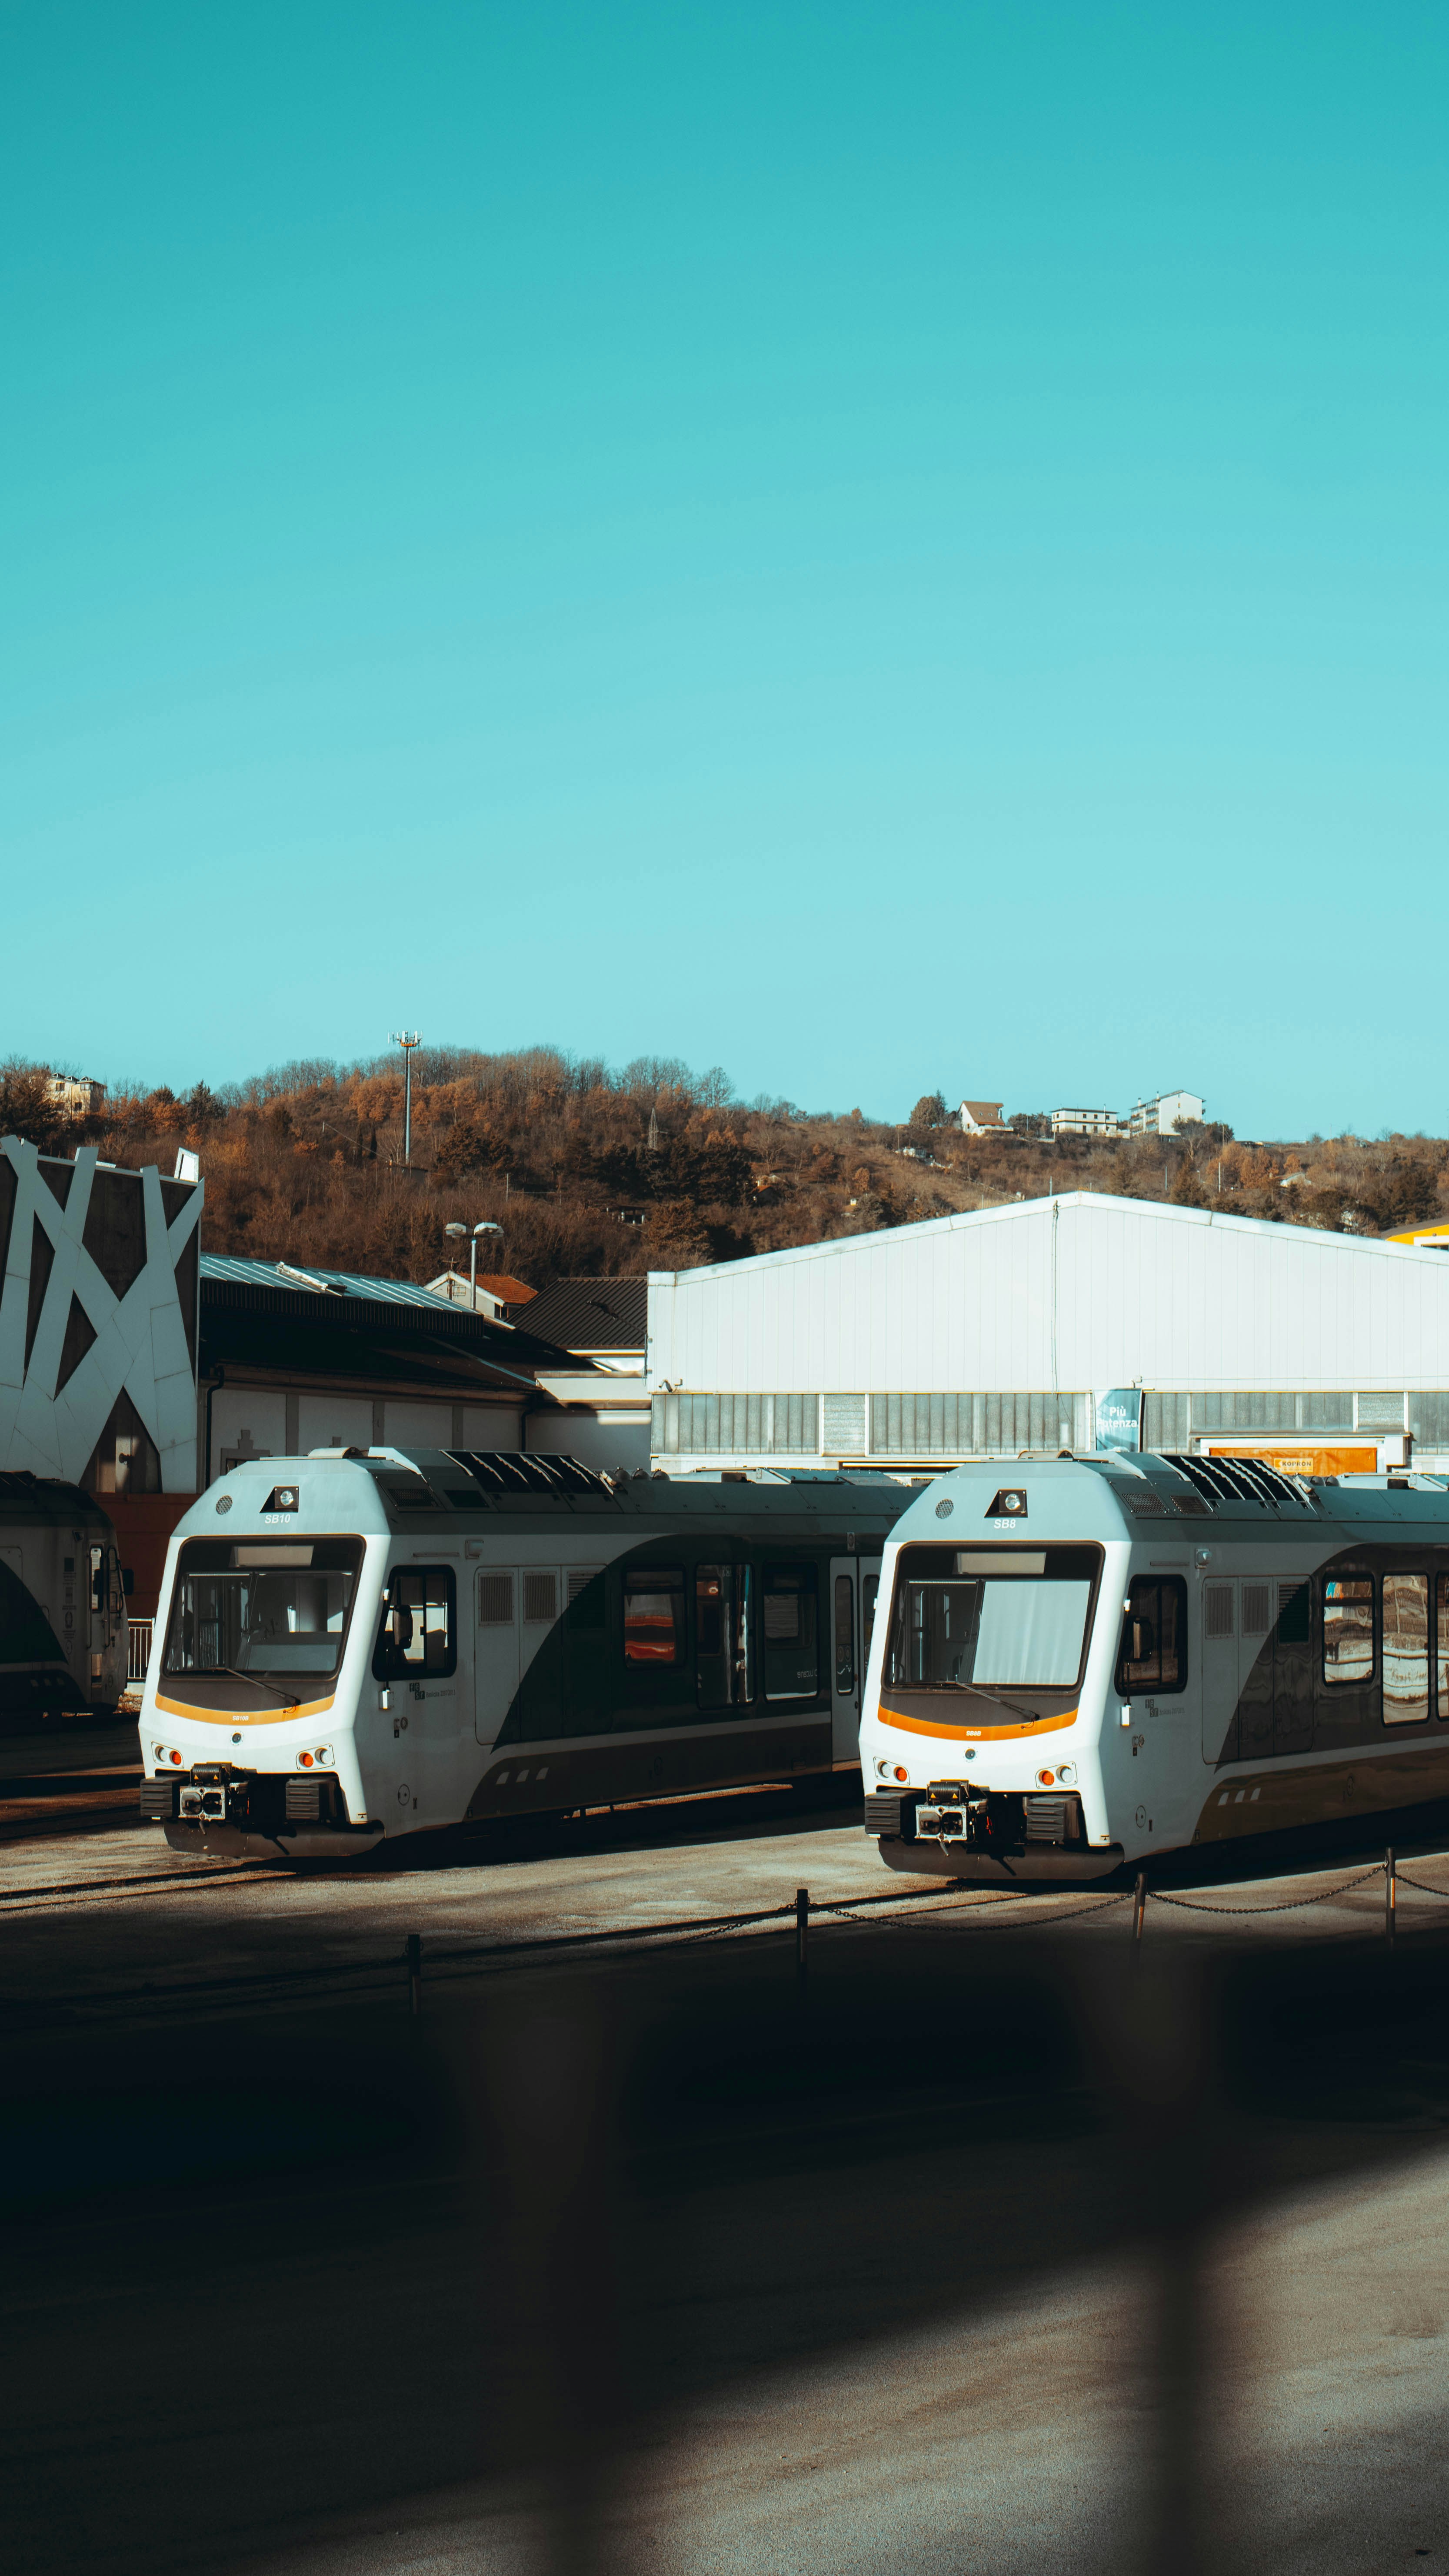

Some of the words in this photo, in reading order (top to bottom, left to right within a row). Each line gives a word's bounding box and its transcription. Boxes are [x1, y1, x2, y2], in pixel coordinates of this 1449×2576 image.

[1109, 1406, 1126, 1416] Più
[264, 1514, 291, 1524] SB10
[994, 1519, 1016, 1529] SB8
